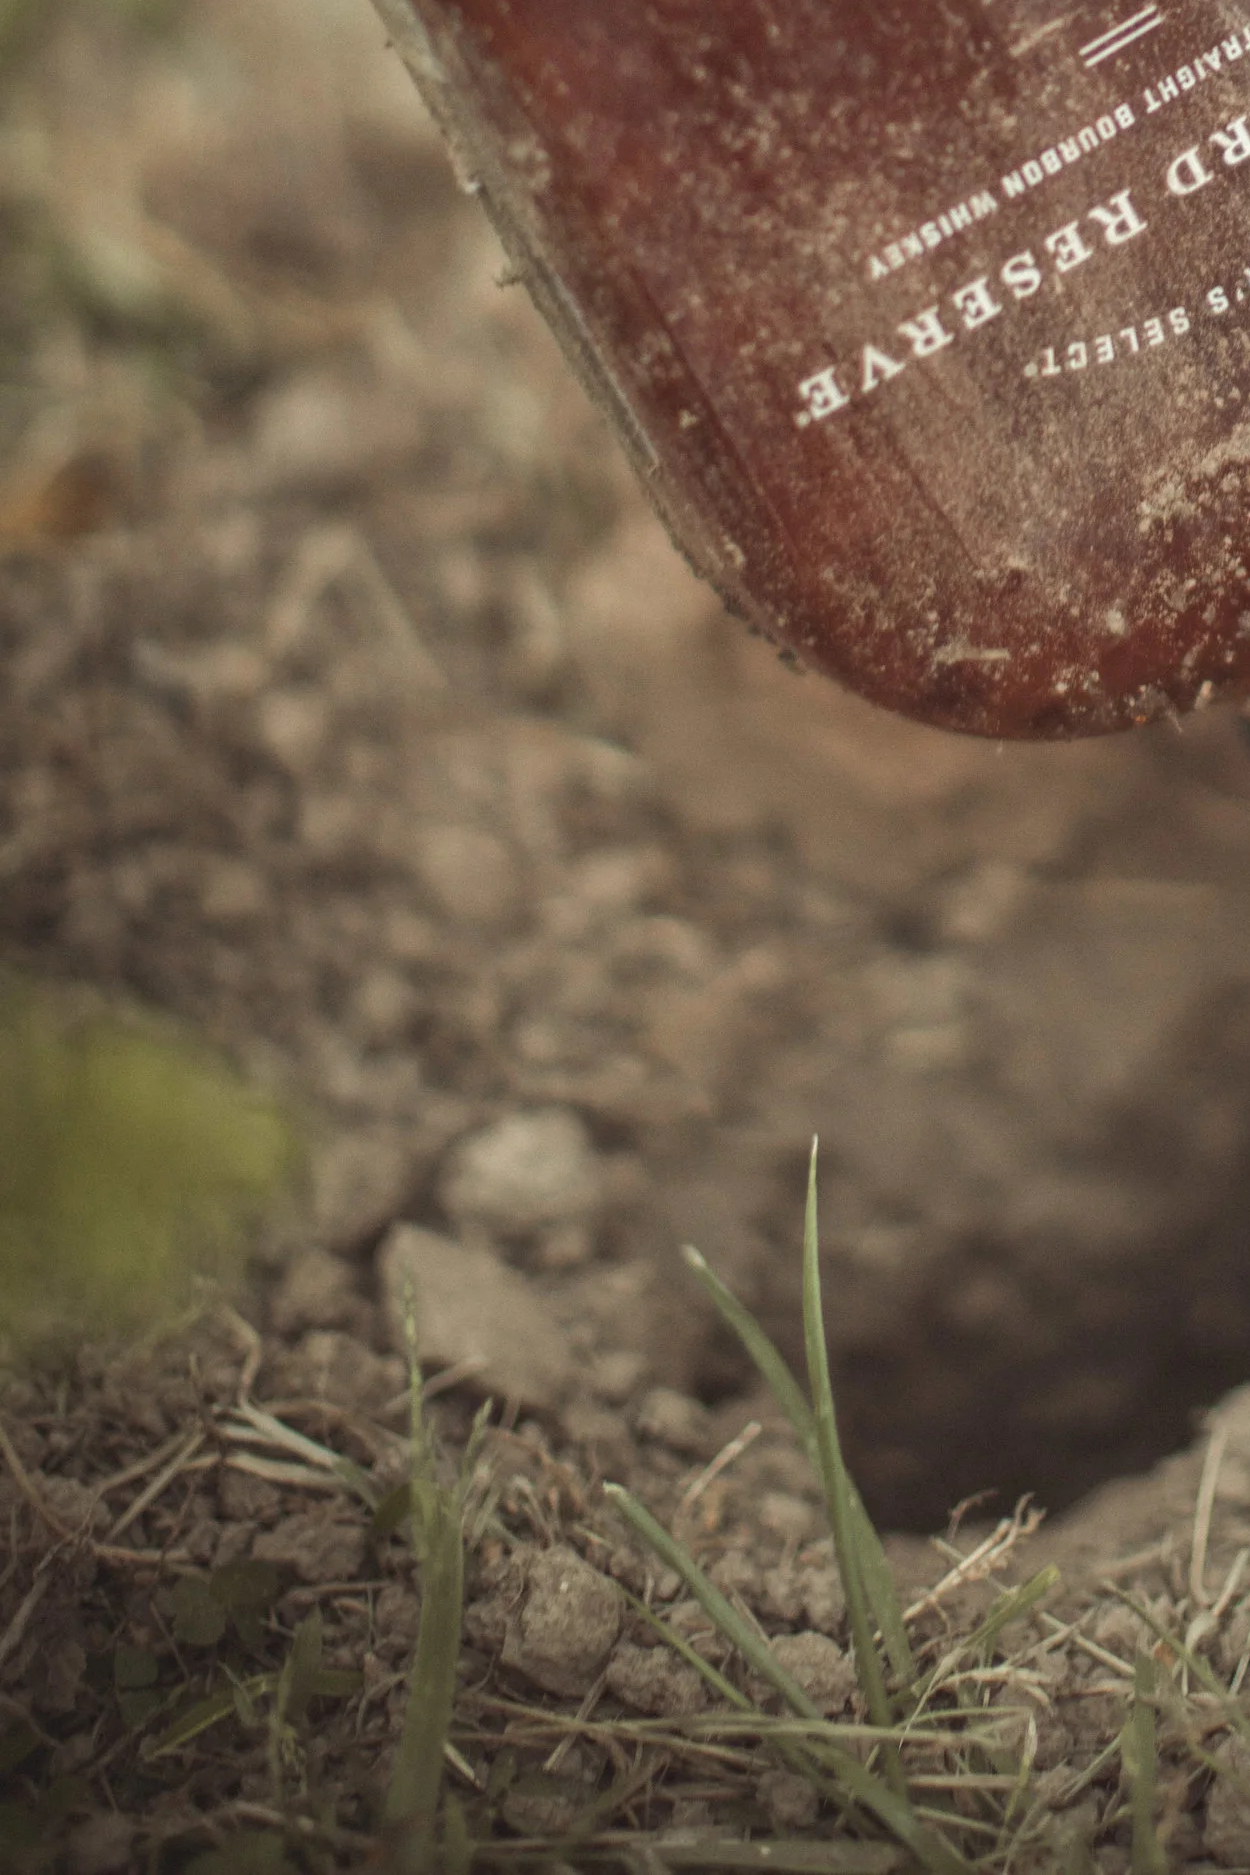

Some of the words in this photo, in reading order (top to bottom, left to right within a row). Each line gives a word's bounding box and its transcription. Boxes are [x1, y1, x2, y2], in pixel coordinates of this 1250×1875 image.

[1001, 103, 1136, 199] BOURBON
[867, 190, 998, 279] WHISKEY
[797, 189, 1148, 420] RESERVE
[1040, 306, 1191, 377] SELECT
